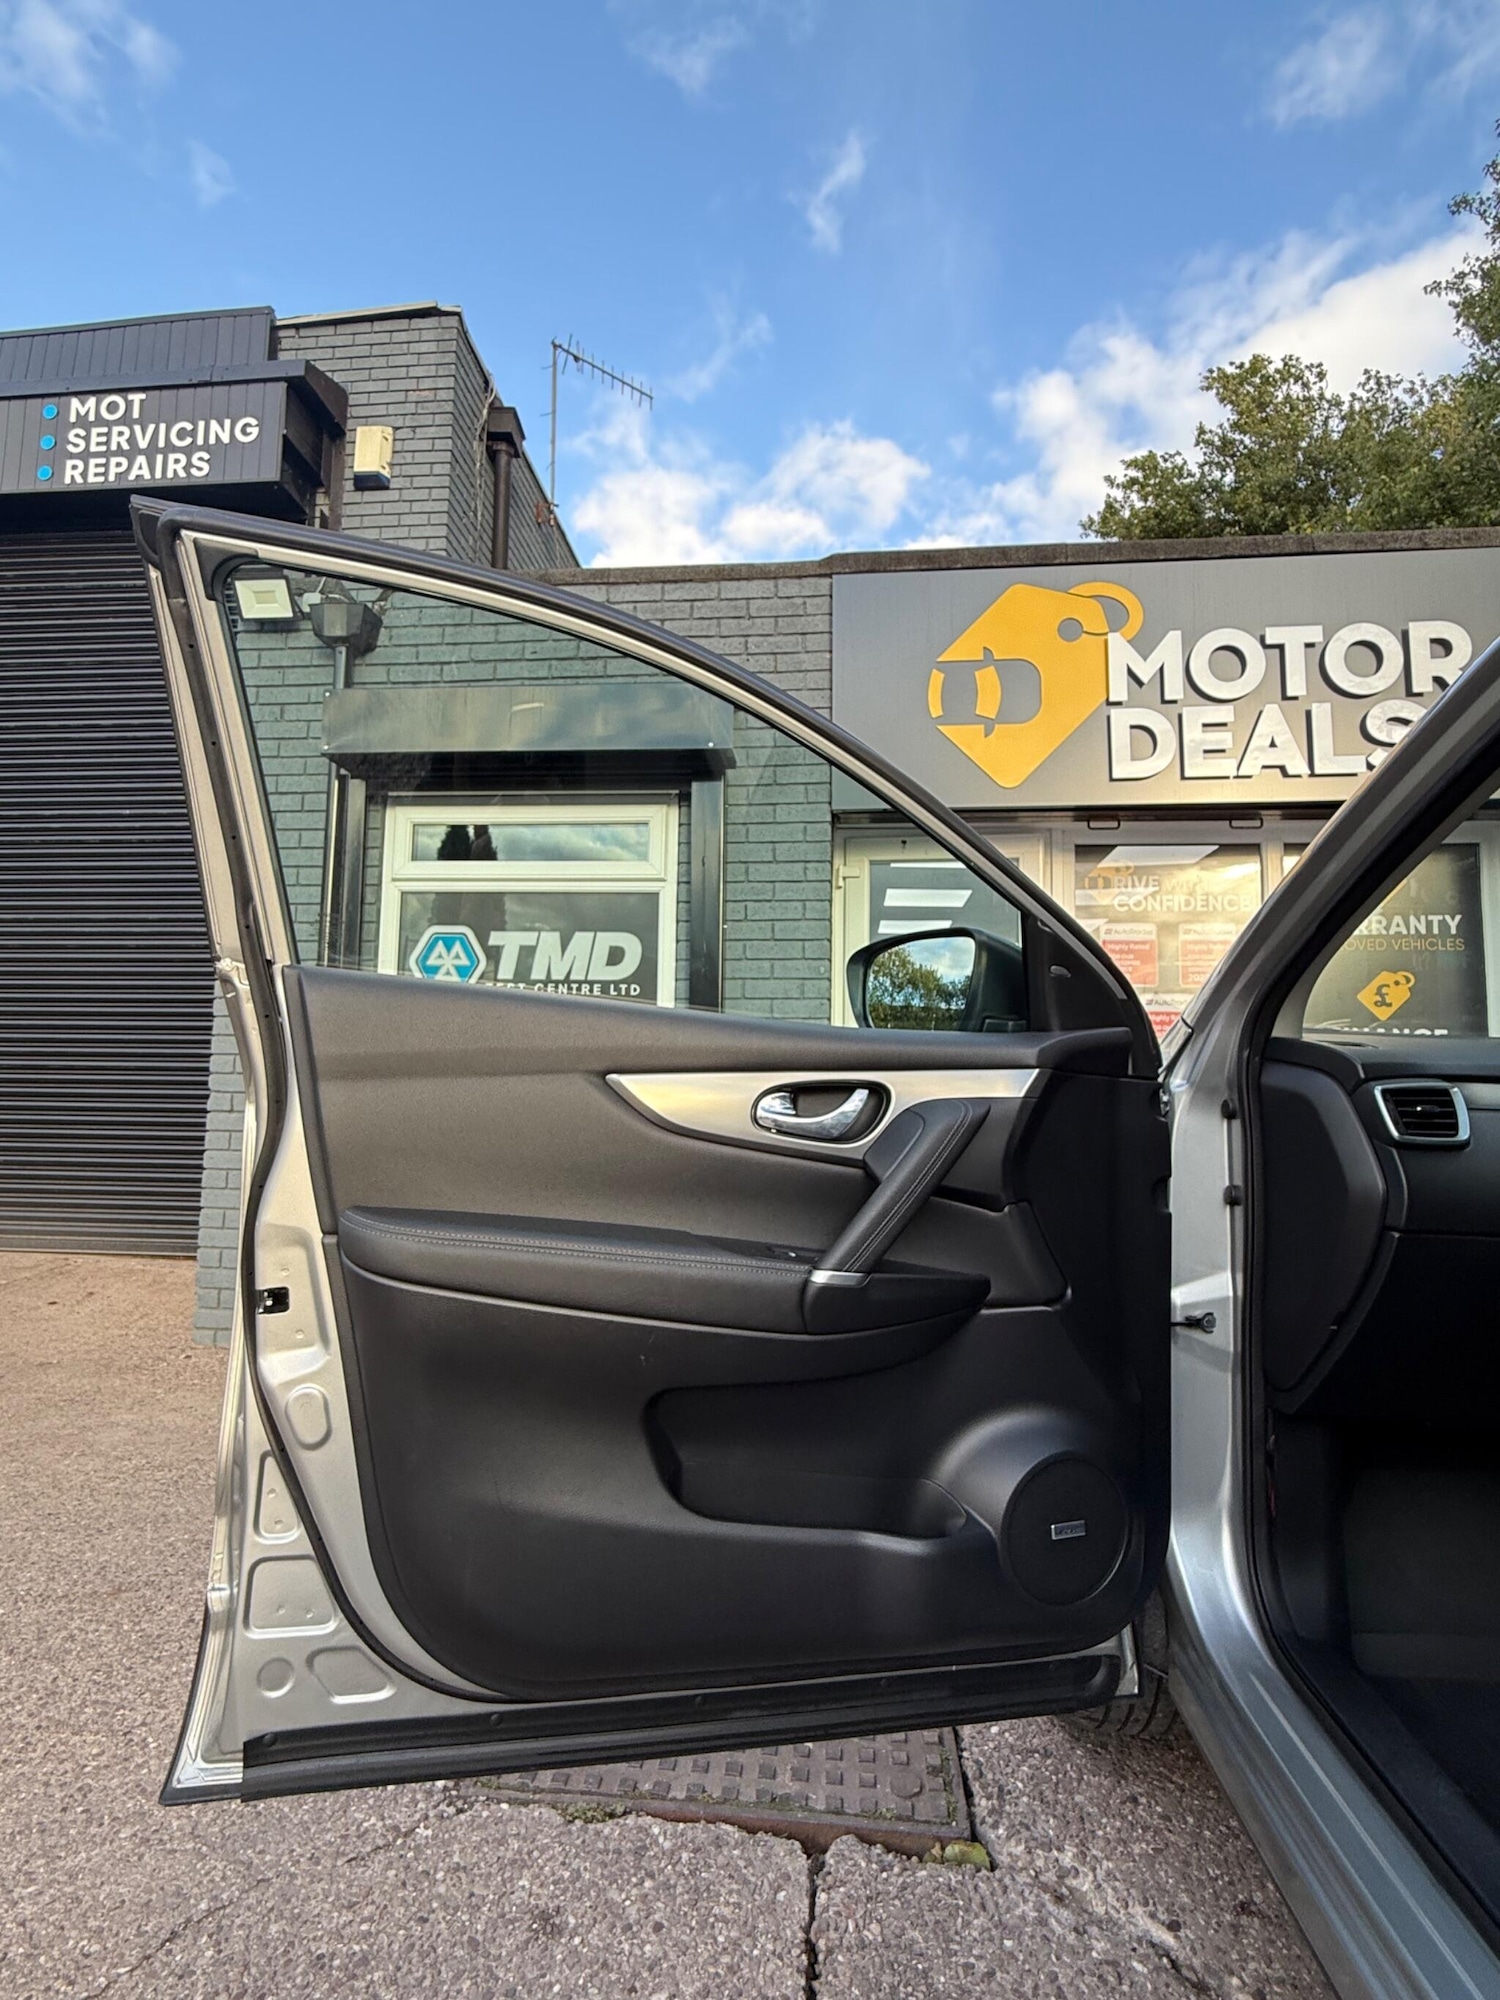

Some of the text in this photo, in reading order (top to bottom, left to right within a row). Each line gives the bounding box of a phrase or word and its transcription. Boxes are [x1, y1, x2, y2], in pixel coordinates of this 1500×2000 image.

[69, 393, 146, 422] MOT
[66, 417, 260, 453] SERVICING
[64, 451, 211, 485] REPAIRS
[1107, 620, 1473, 702] MOTOR
[1112, 894, 1251, 912] CONFIDENCE
[488, 931, 642, 981] TMD
[1392, 938, 1465, 951] VEHICLES
[534, 983, 602, 996] CENTRE
[610, 984, 641, 996] LTD
